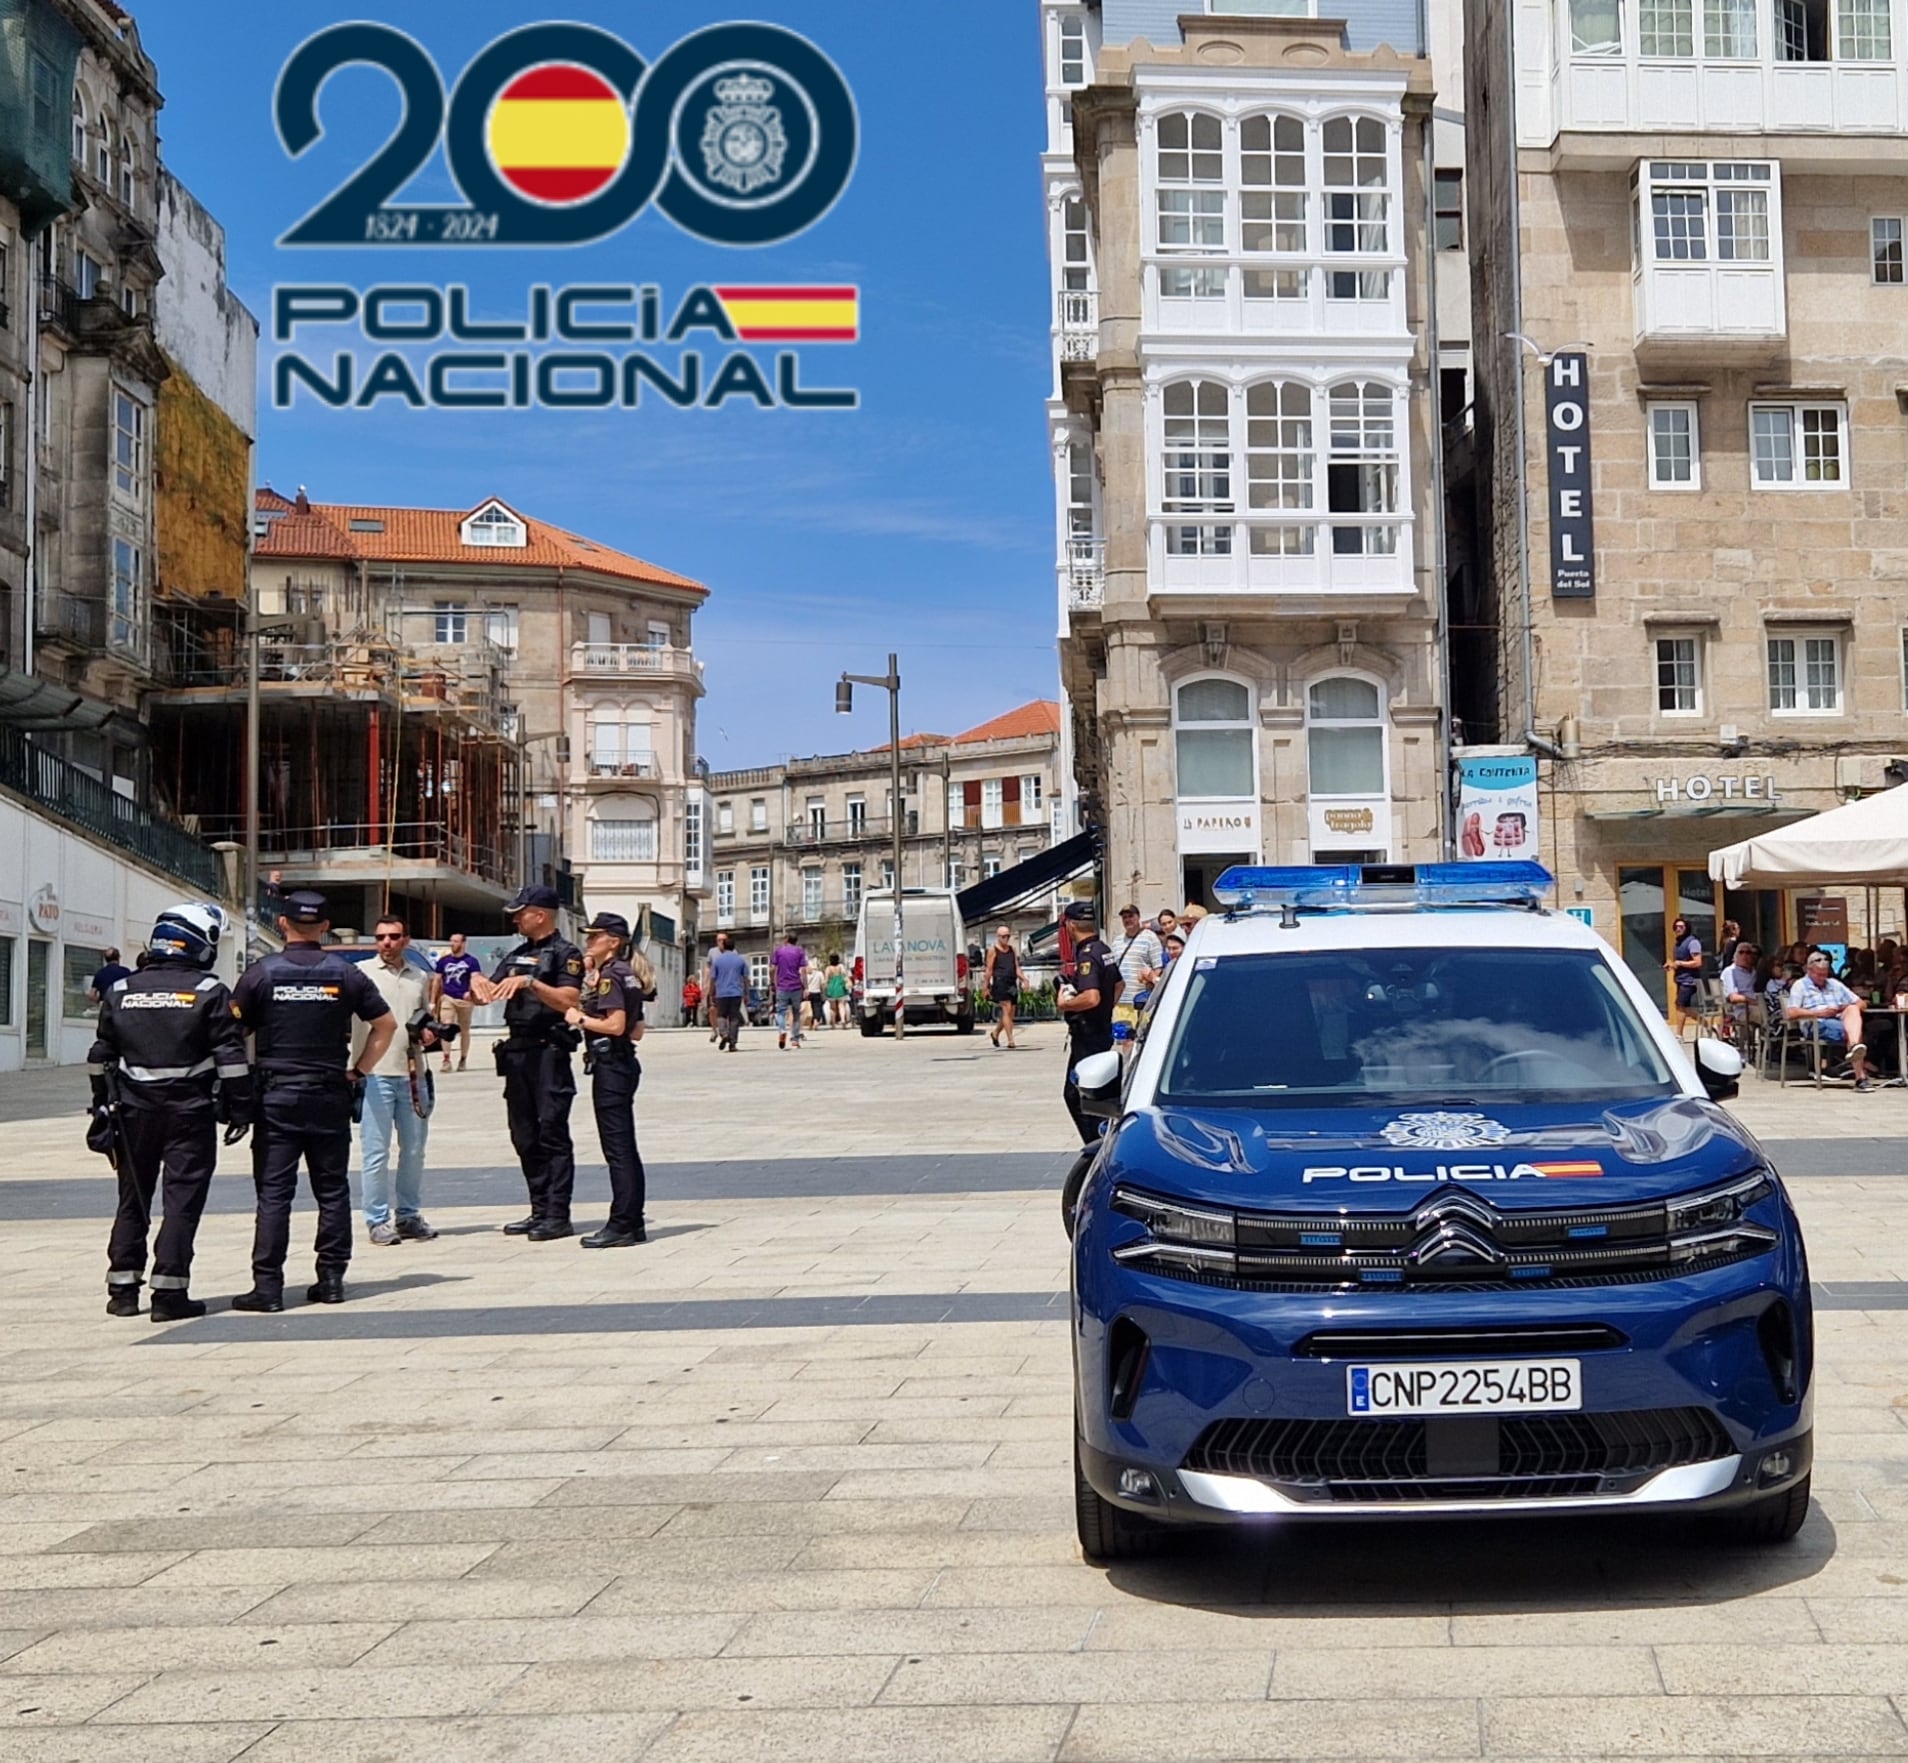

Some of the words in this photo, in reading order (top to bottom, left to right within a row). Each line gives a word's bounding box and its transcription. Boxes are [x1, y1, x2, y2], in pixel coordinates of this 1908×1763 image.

[1552, 359, 1584, 561] HOTEL
[1557, 569, 1589, 577] Puerta
[1557, 580, 1572, 588] del
[1574, 580, 1590, 588] Sol
[1656, 775, 1783, 801] HOTEL
[1682, 888, 1710, 896] Hotel
[273, 993, 339, 1001] NACIONAL
[121, 1000, 193, 1009] NACIONAL
[1302, 1164, 1546, 1183] POLICIA
[1371, 1367, 1571, 1407] CNP2254BB
